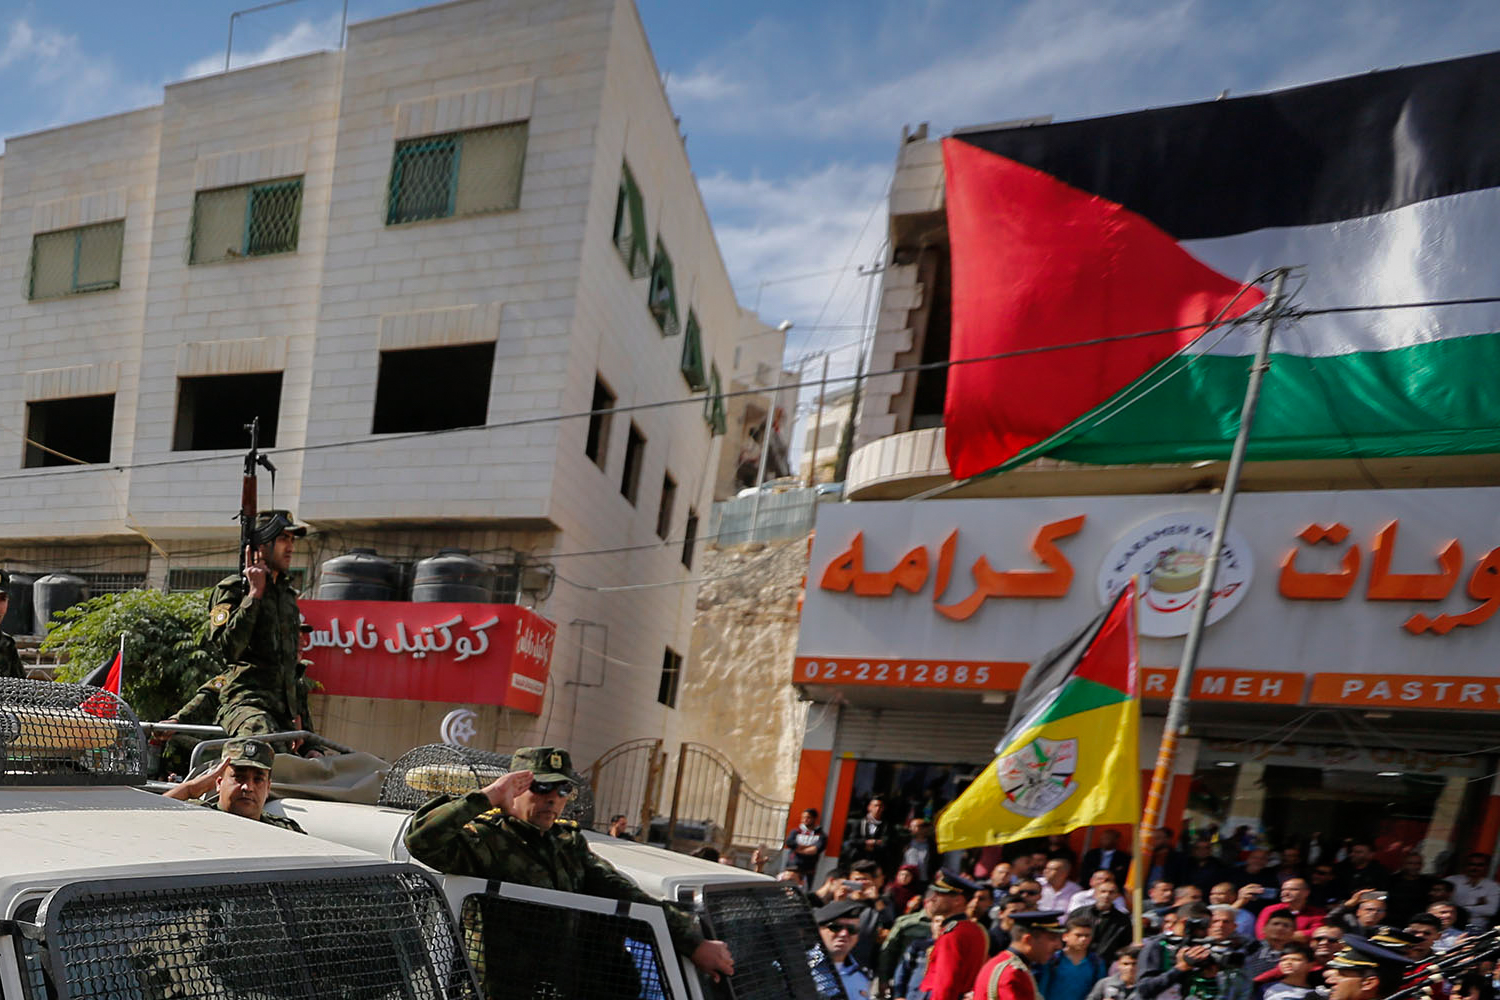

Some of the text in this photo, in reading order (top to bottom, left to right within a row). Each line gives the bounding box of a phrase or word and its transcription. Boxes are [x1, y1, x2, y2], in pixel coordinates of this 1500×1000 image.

[820, 514, 1087, 621] كرامه
[384, 614, 499, 662] كوكتيل
[805, 661, 991, 685] 02-2212885
[1145, 673, 1500, 704] RMEH PASTR
